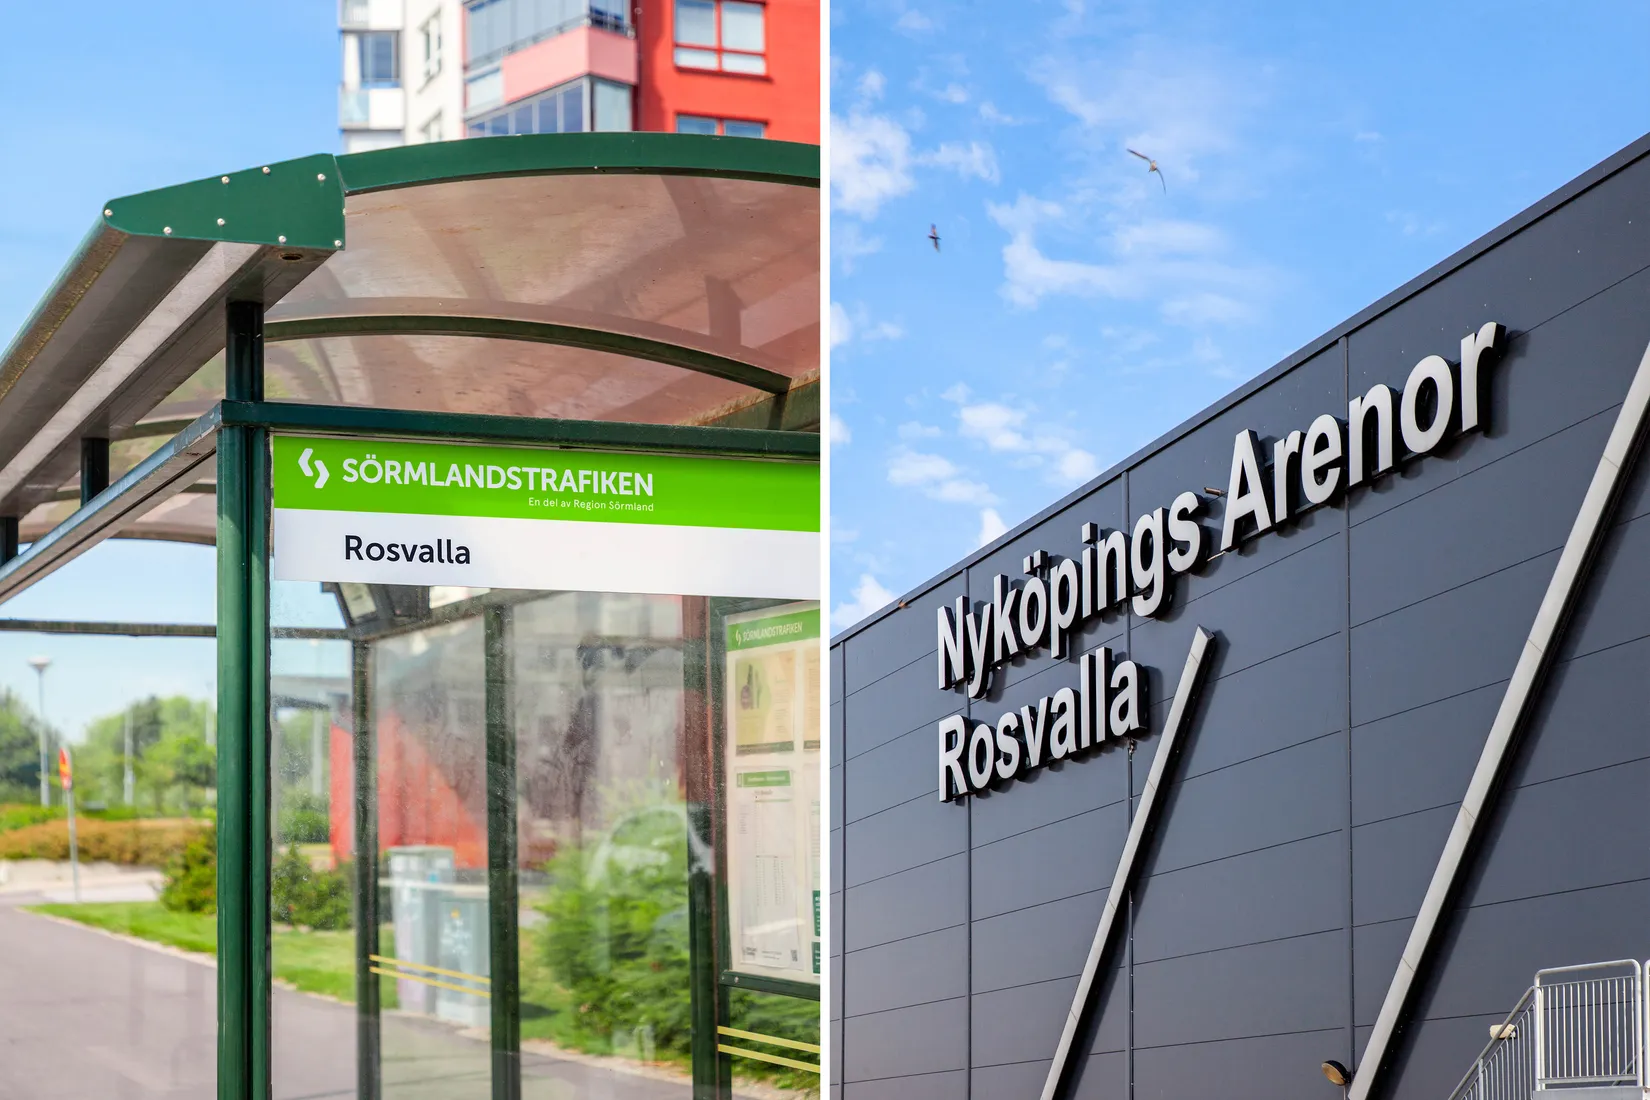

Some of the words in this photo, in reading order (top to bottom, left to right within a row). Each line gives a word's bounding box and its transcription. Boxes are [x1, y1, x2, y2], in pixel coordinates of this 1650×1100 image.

[342, 453, 654, 496] SÖRMLANDSTRAFIKEN
[528, 497, 540, 507] En
[542, 497, 558, 507] del
[560, 500, 571, 508] av
[573, 499, 606, 511] Region
[608, 500, 654, 512] Sörmland
[937, 491, 1201, 699] Nyköpings
[1220, 321, 1504, 554] Arenor
[344, 534, 472, 565] Rosvalla
[938, 646, 1143, 803] Rosvalla
